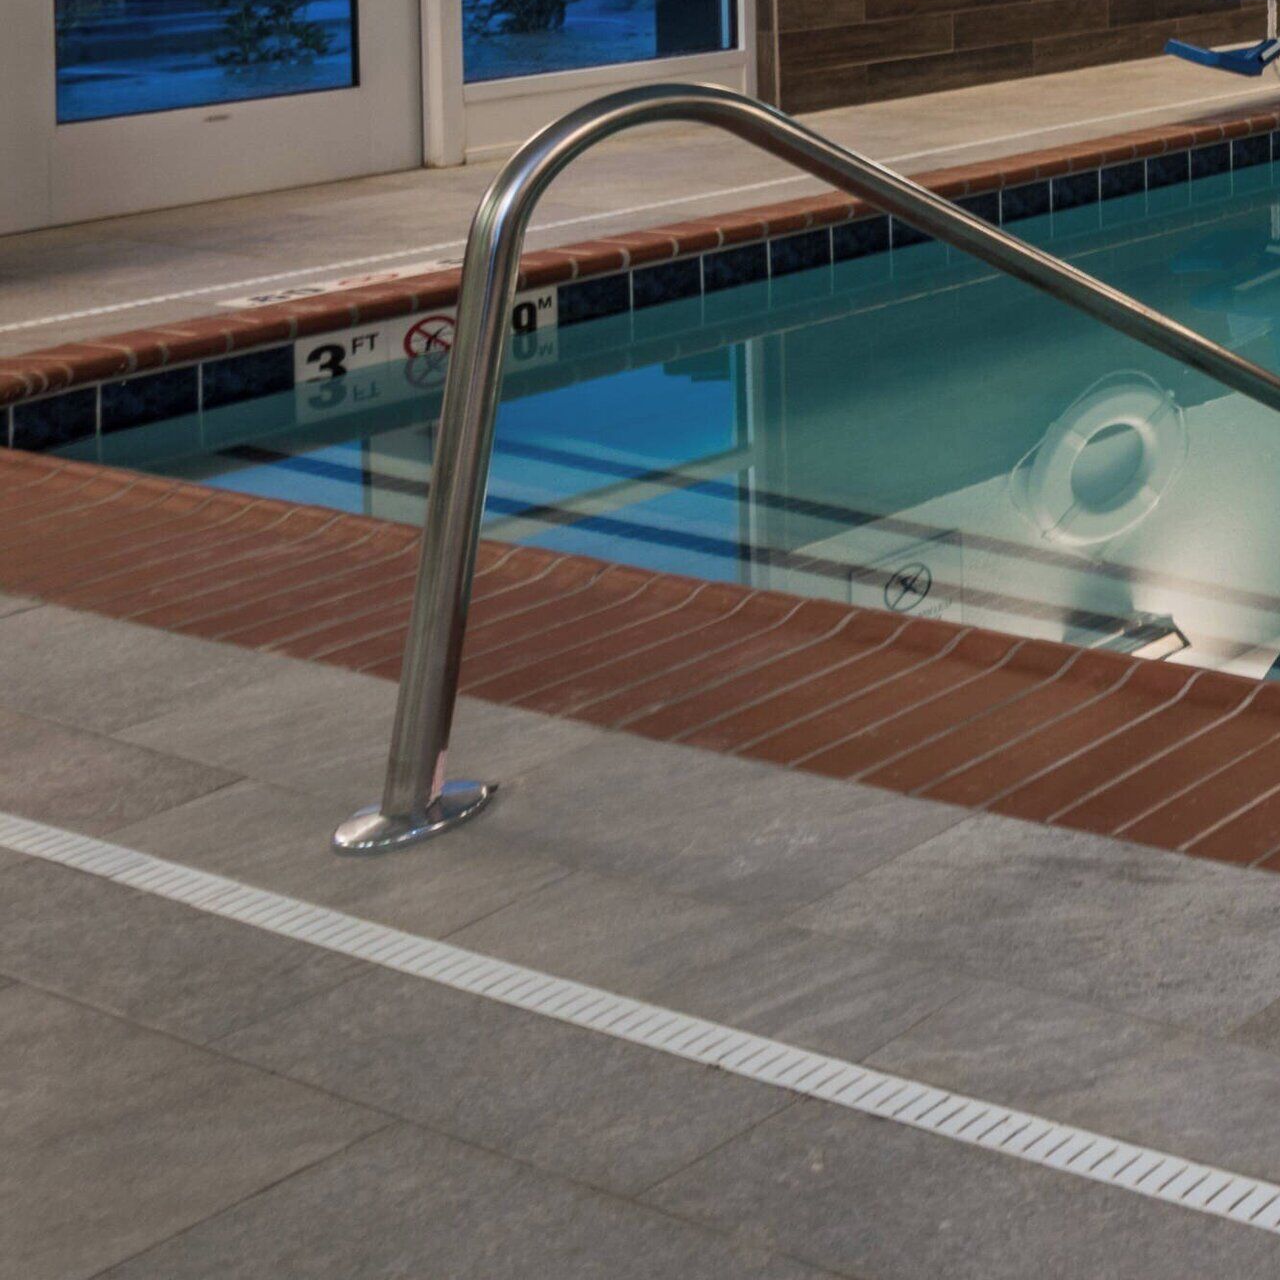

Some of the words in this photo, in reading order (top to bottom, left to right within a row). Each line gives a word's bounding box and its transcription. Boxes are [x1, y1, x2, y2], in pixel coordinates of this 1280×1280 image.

[306, 344, 347, 383] 3
[352, 332, 379, 356] FT
[538, 296, 552, 310] M
